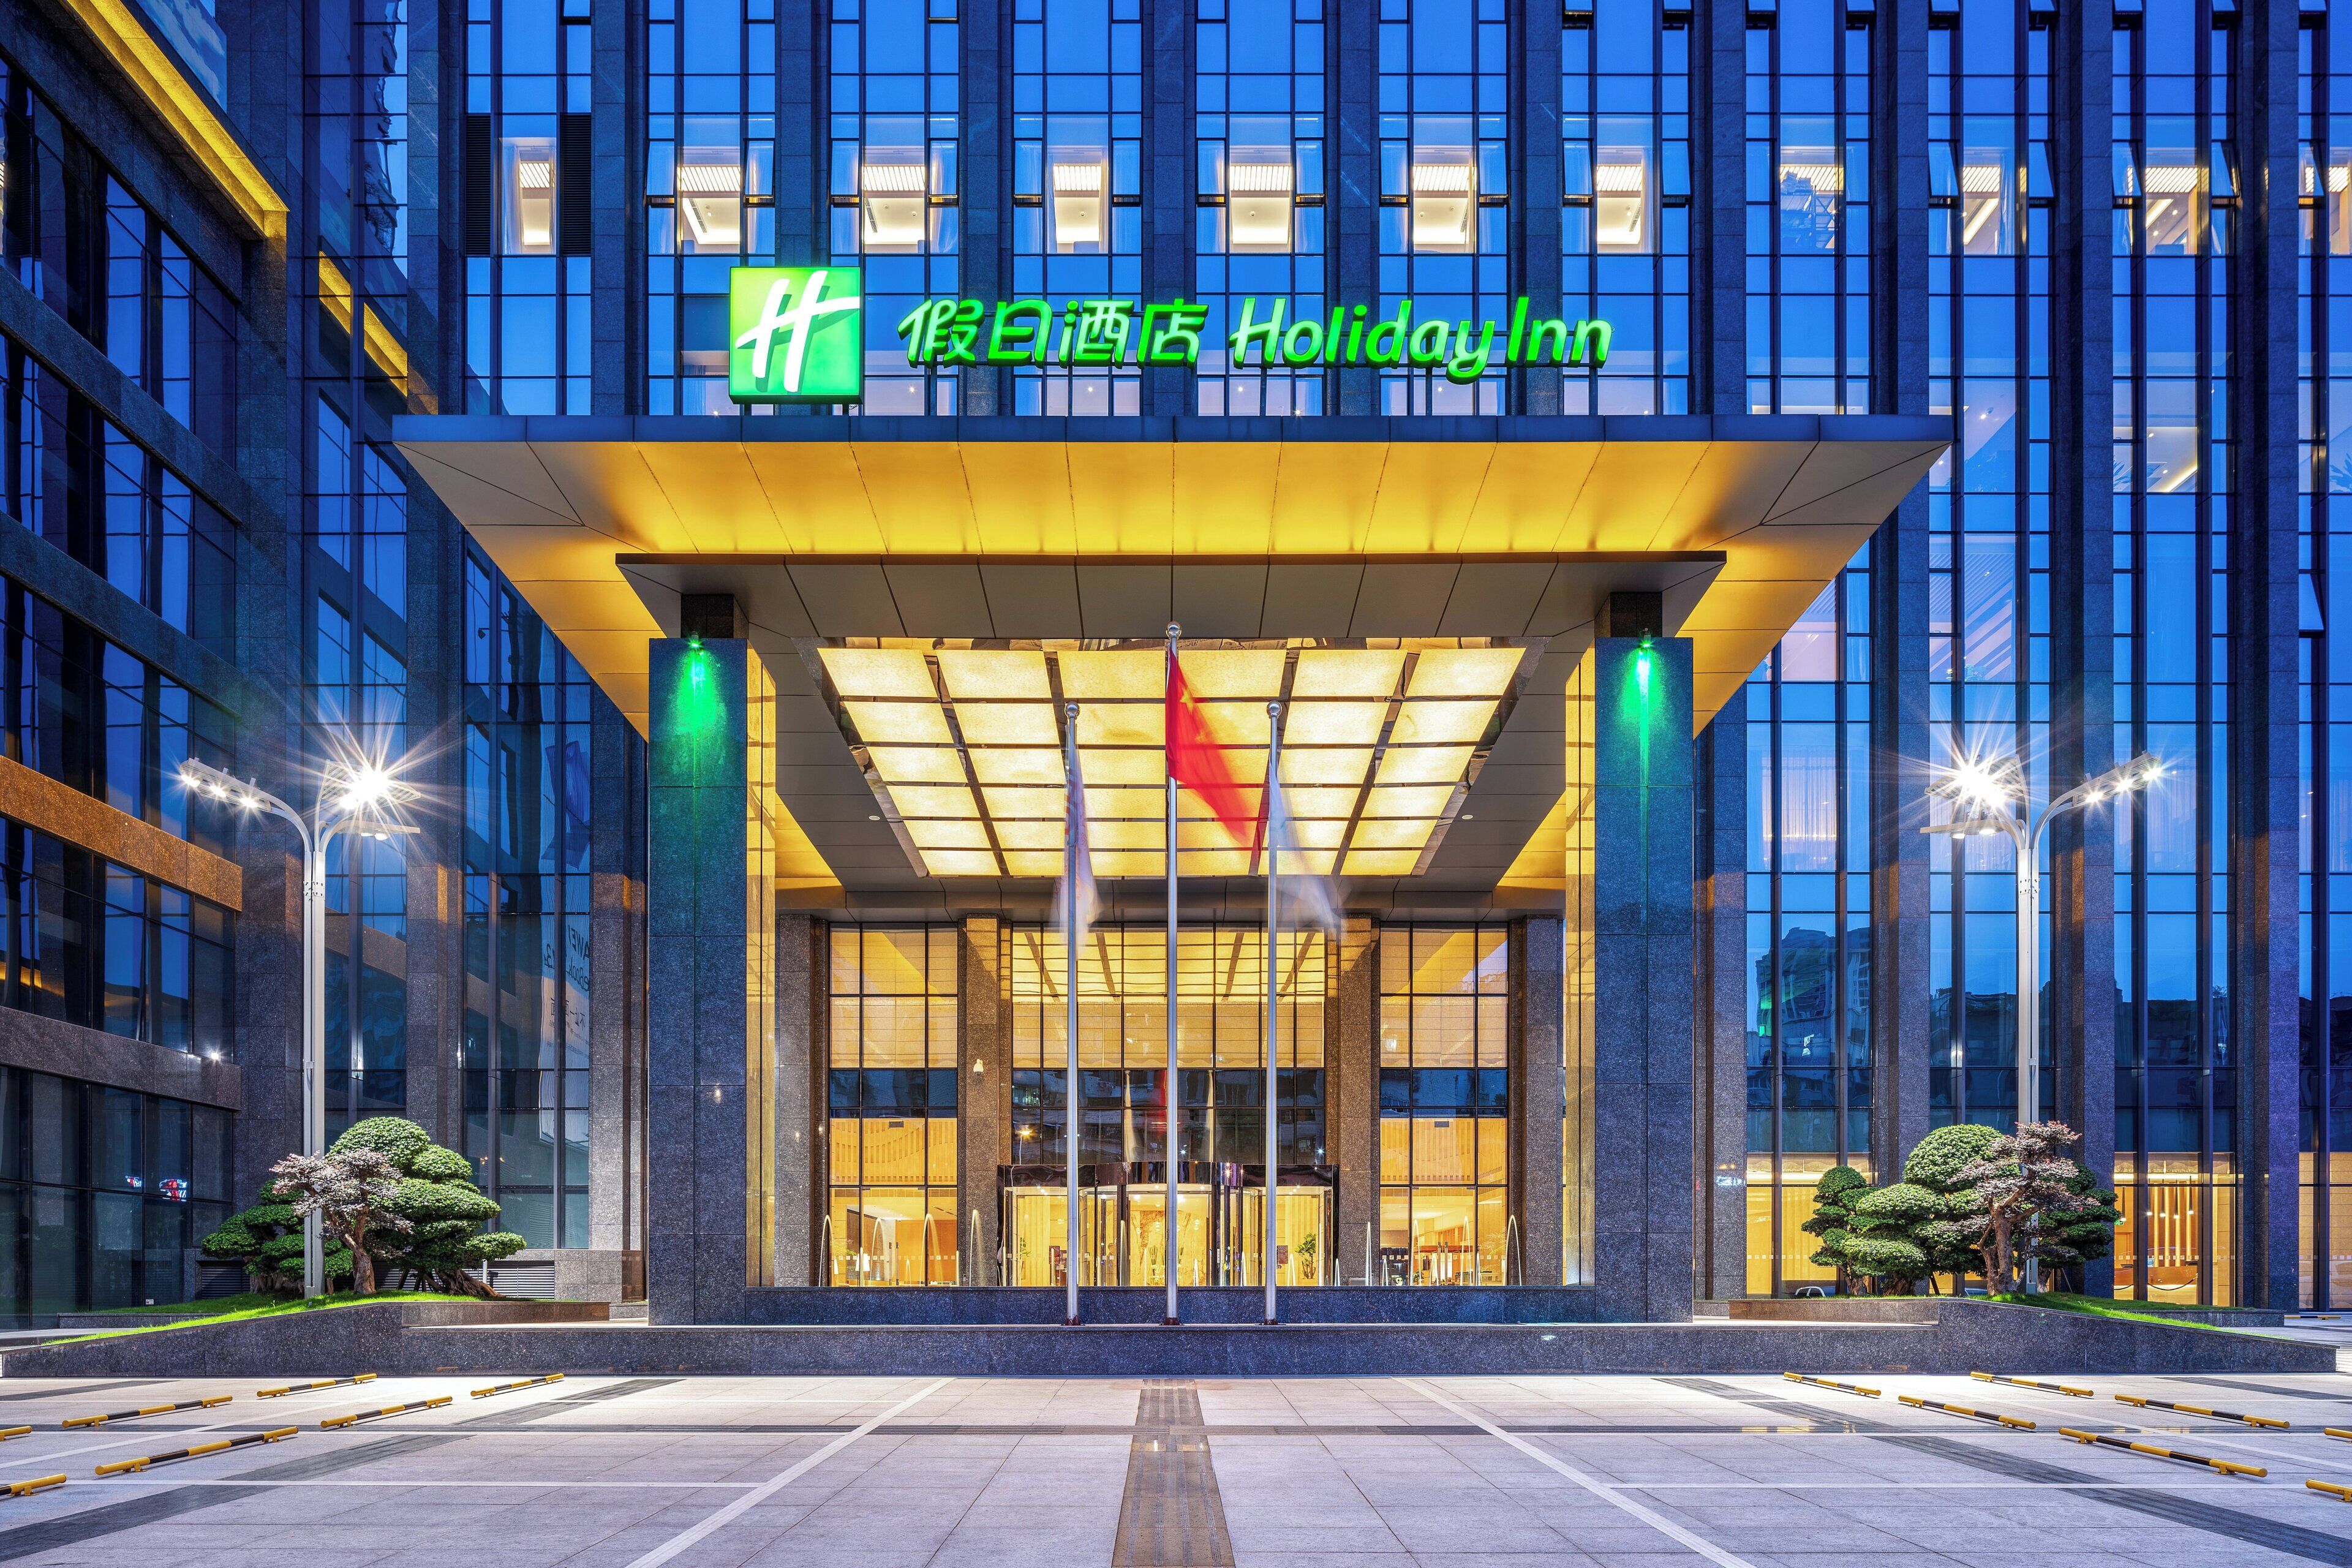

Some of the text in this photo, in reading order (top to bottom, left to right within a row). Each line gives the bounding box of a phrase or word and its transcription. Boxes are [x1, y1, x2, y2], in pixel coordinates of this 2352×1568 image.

[897, 298, 1209, 369] 假日酒店
[1229, 296, 1613, 385] Holiday Inn
